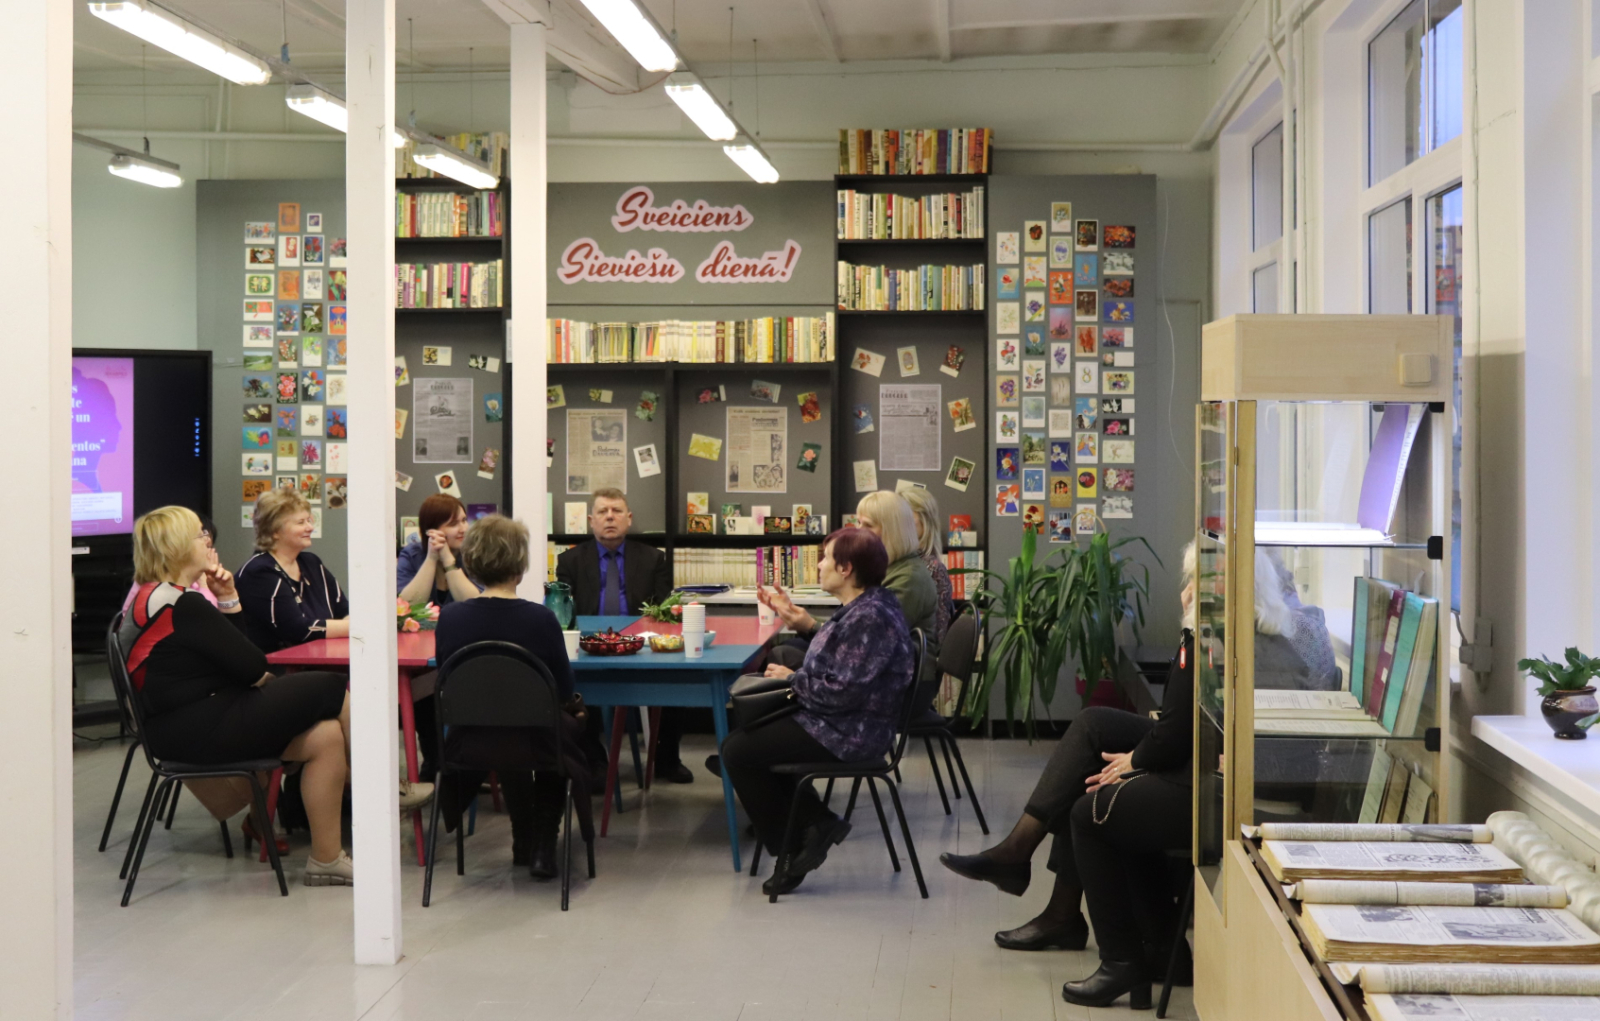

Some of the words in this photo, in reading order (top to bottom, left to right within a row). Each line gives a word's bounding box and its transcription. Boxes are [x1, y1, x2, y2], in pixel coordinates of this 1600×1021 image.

[617, 190, 749, 228] Sveiciens
[563, 241, 680, 280] Sieviešu
[700, 244, 797, 279] dienā!
